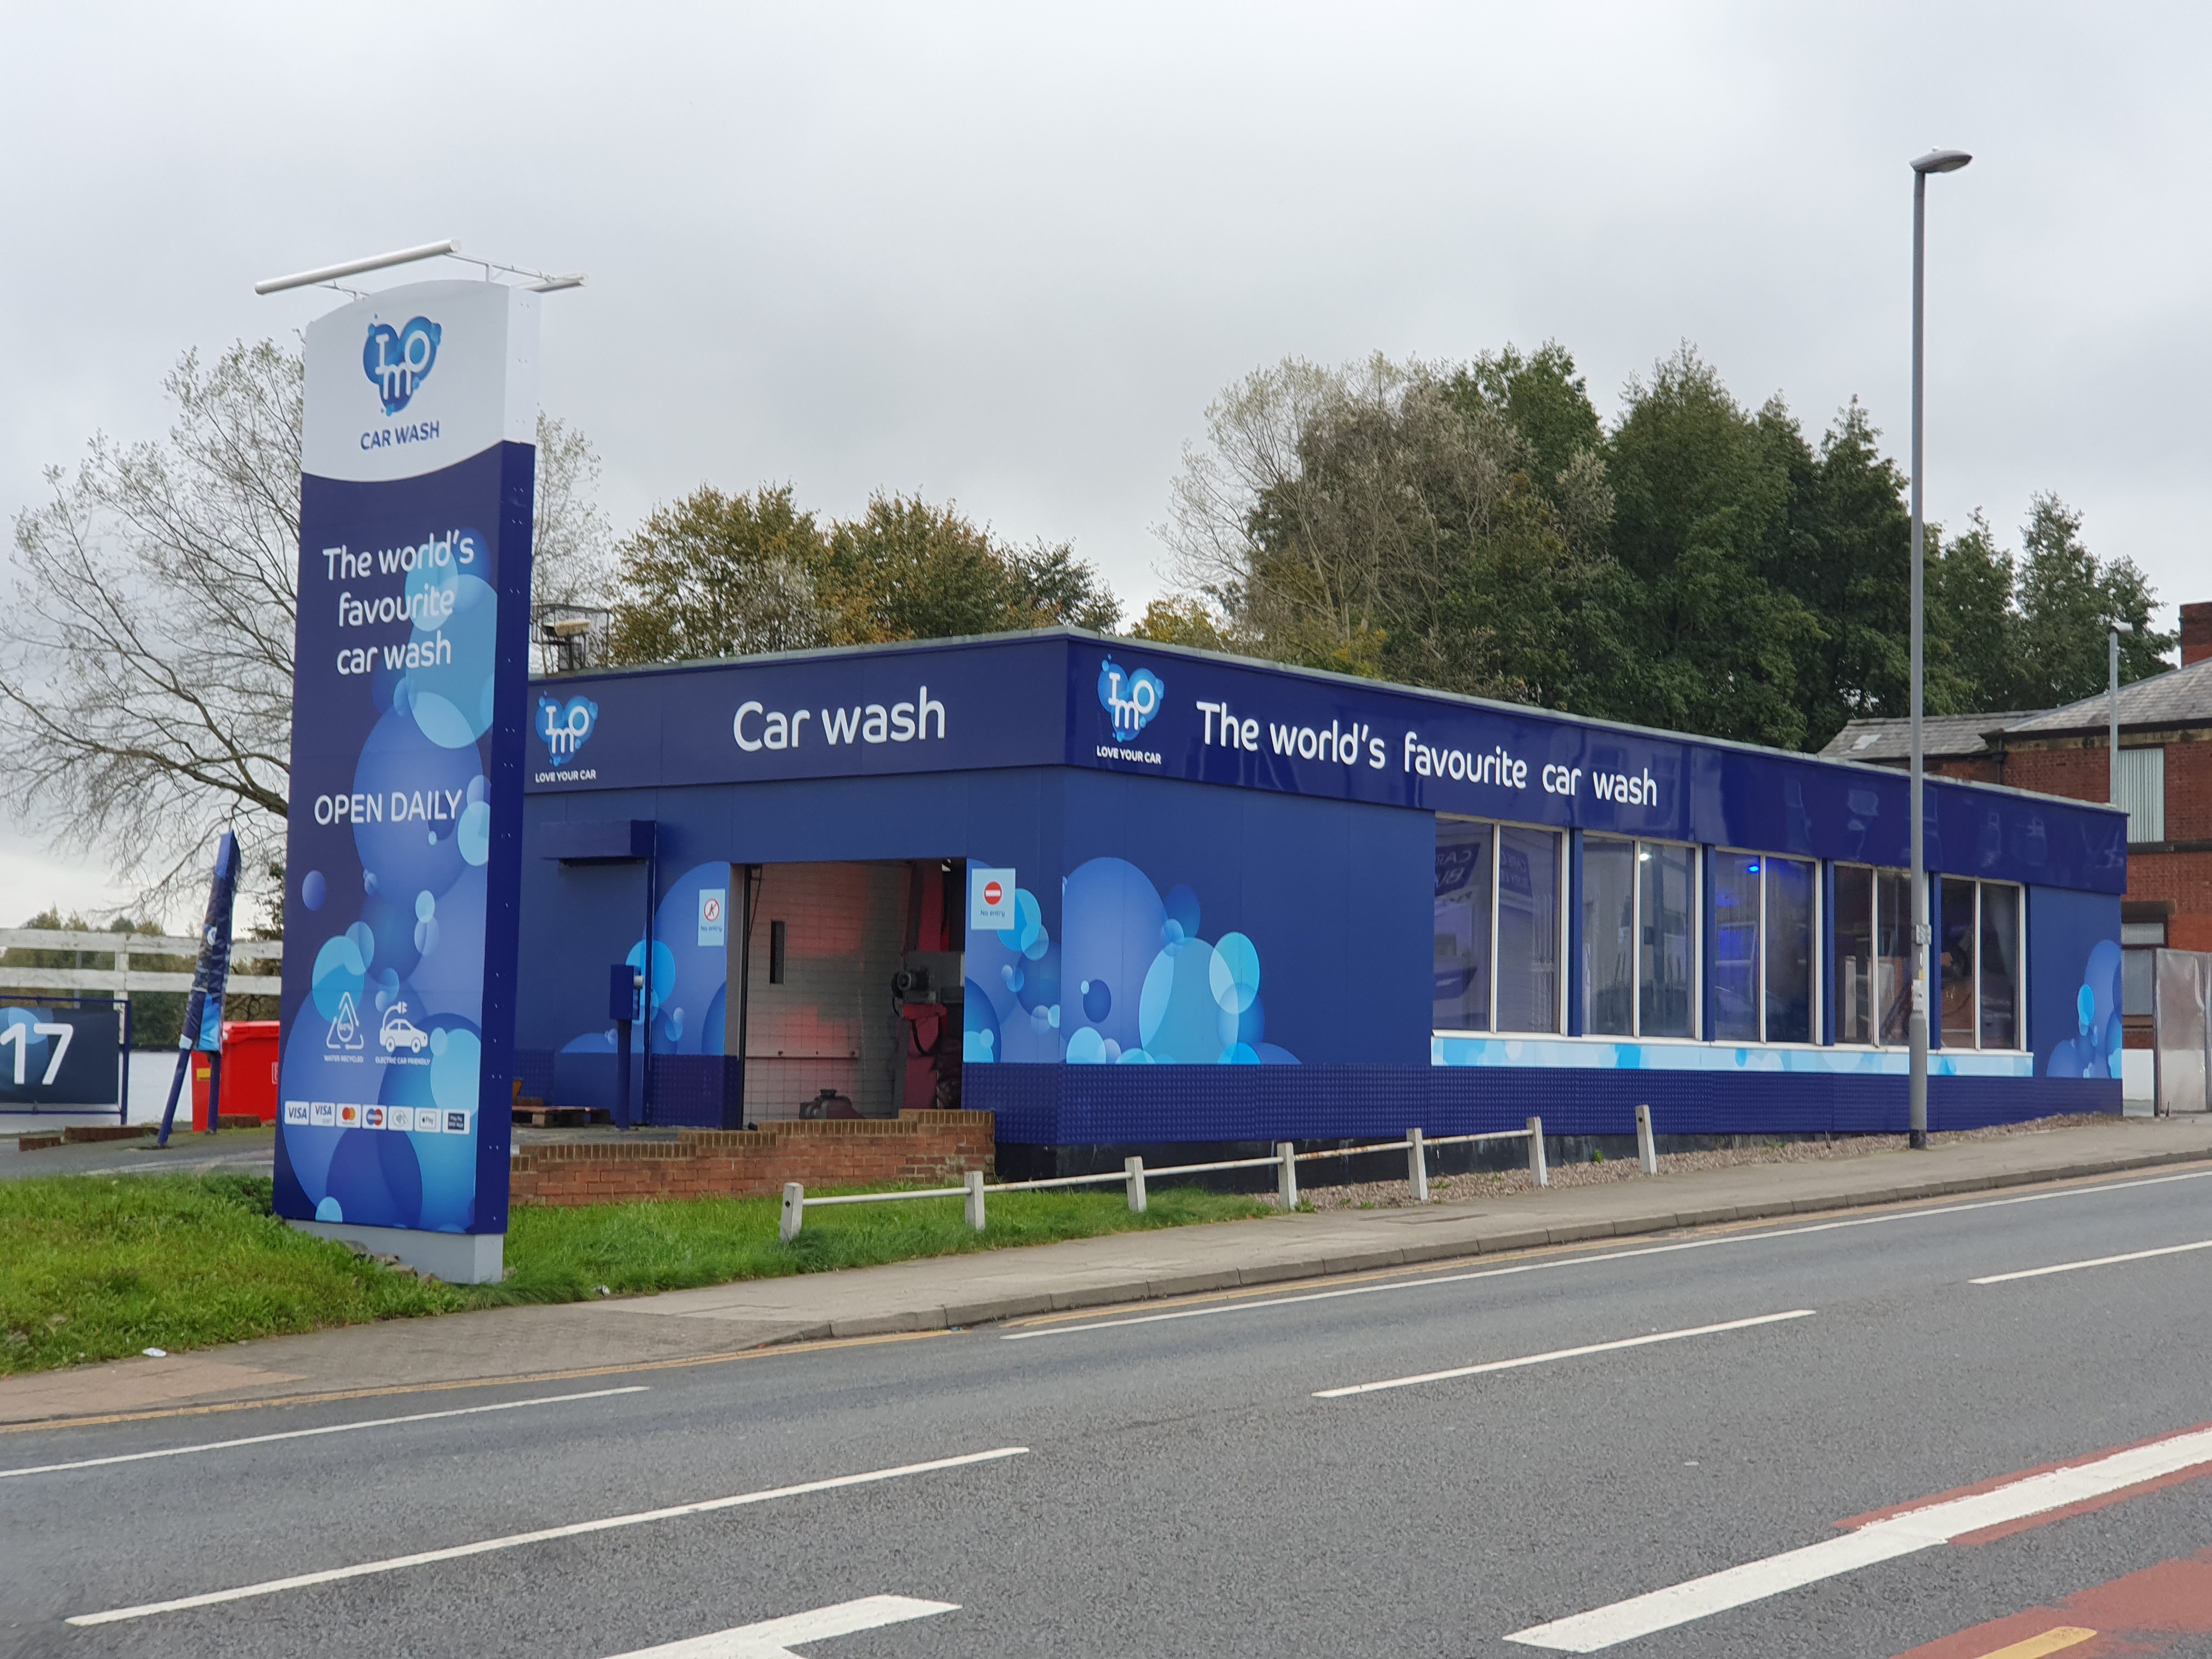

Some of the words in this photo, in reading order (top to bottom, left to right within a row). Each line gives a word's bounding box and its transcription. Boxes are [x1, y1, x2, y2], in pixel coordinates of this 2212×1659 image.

[360, 429, 391, 450] CAR
[394, 419, 440, 445] WASH
[322, 544, 373, 581] The
[378, 529, 475, 574] world's
[338, 583, 455, 627] favourite
[336, 646, 379, 675] car
[383, 629, 452, 670] wash
[733, 701, 810, 752] Car
[821, 685, 945, 746] wash
[1097, 745, 1119, 759] LOVE
[1120, 748, 1143, 763] YOUR
[1144, 751, 1162, 765] CAR
[1196, 700, 1260, 752] The
[1269, 719, 1386, 769] world's
[1404, 731, 1528, 789] favourite
[1542, 763, 1582, 796] car
[1592, 767, 1657, 807] wash
[535, 771, 555, 783] LOVE
[556, 770, 579, 781] YOUR
[580, 769, 596, 780] CAR
[314, 793, 382, 825] OPEN
[391, 789, 462, 822] DAILY
[288, 1107, 307, 1119] VISA
[314, 1104, 332, 1116] VISA
